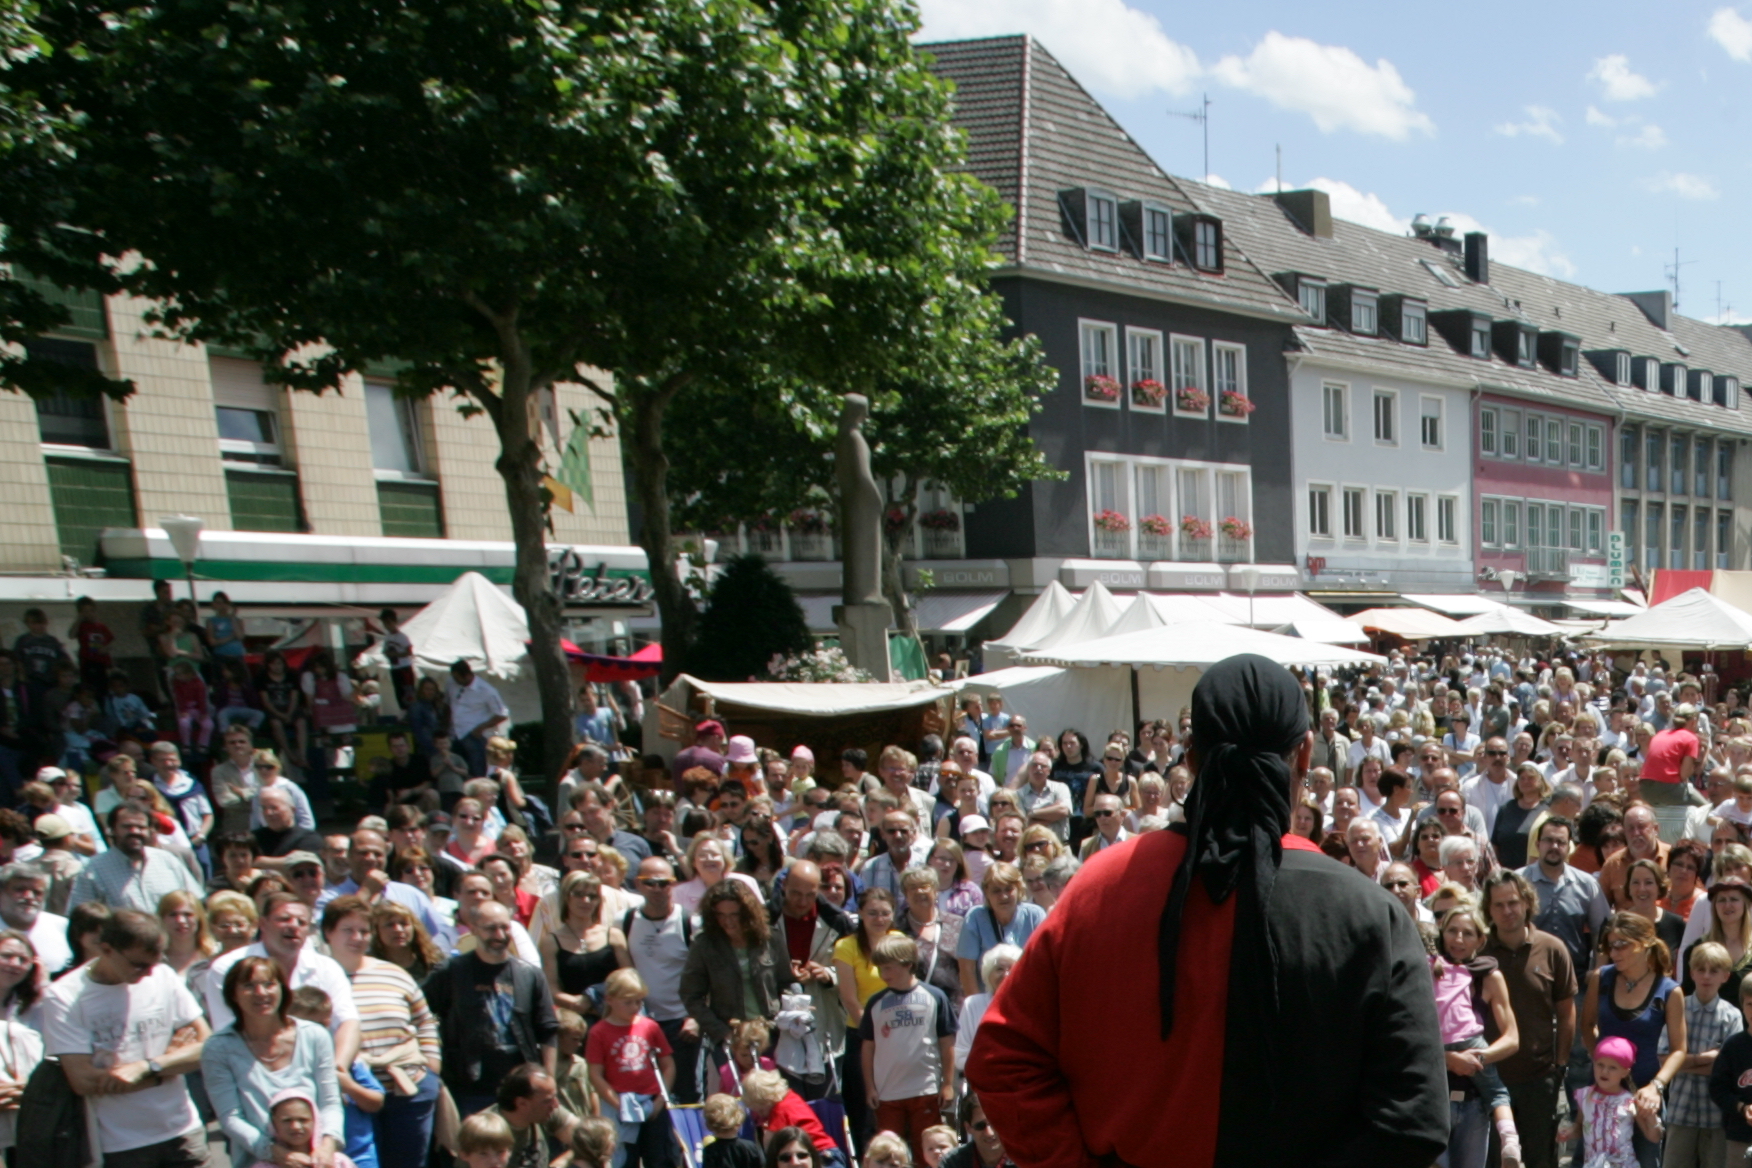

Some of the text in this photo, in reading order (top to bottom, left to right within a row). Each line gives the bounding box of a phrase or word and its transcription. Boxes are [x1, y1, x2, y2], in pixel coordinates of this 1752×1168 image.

[1610, 534, 1622, 585] BLUMEN
[548, 547, 655, 600] Peter
[943, 572, 994, 583] BOLM
[1100, 573, 1142, 585] BOLM
[1185, 575, 1223, 586] BOLM
[1262, 576, 1297, 586] BOLM
